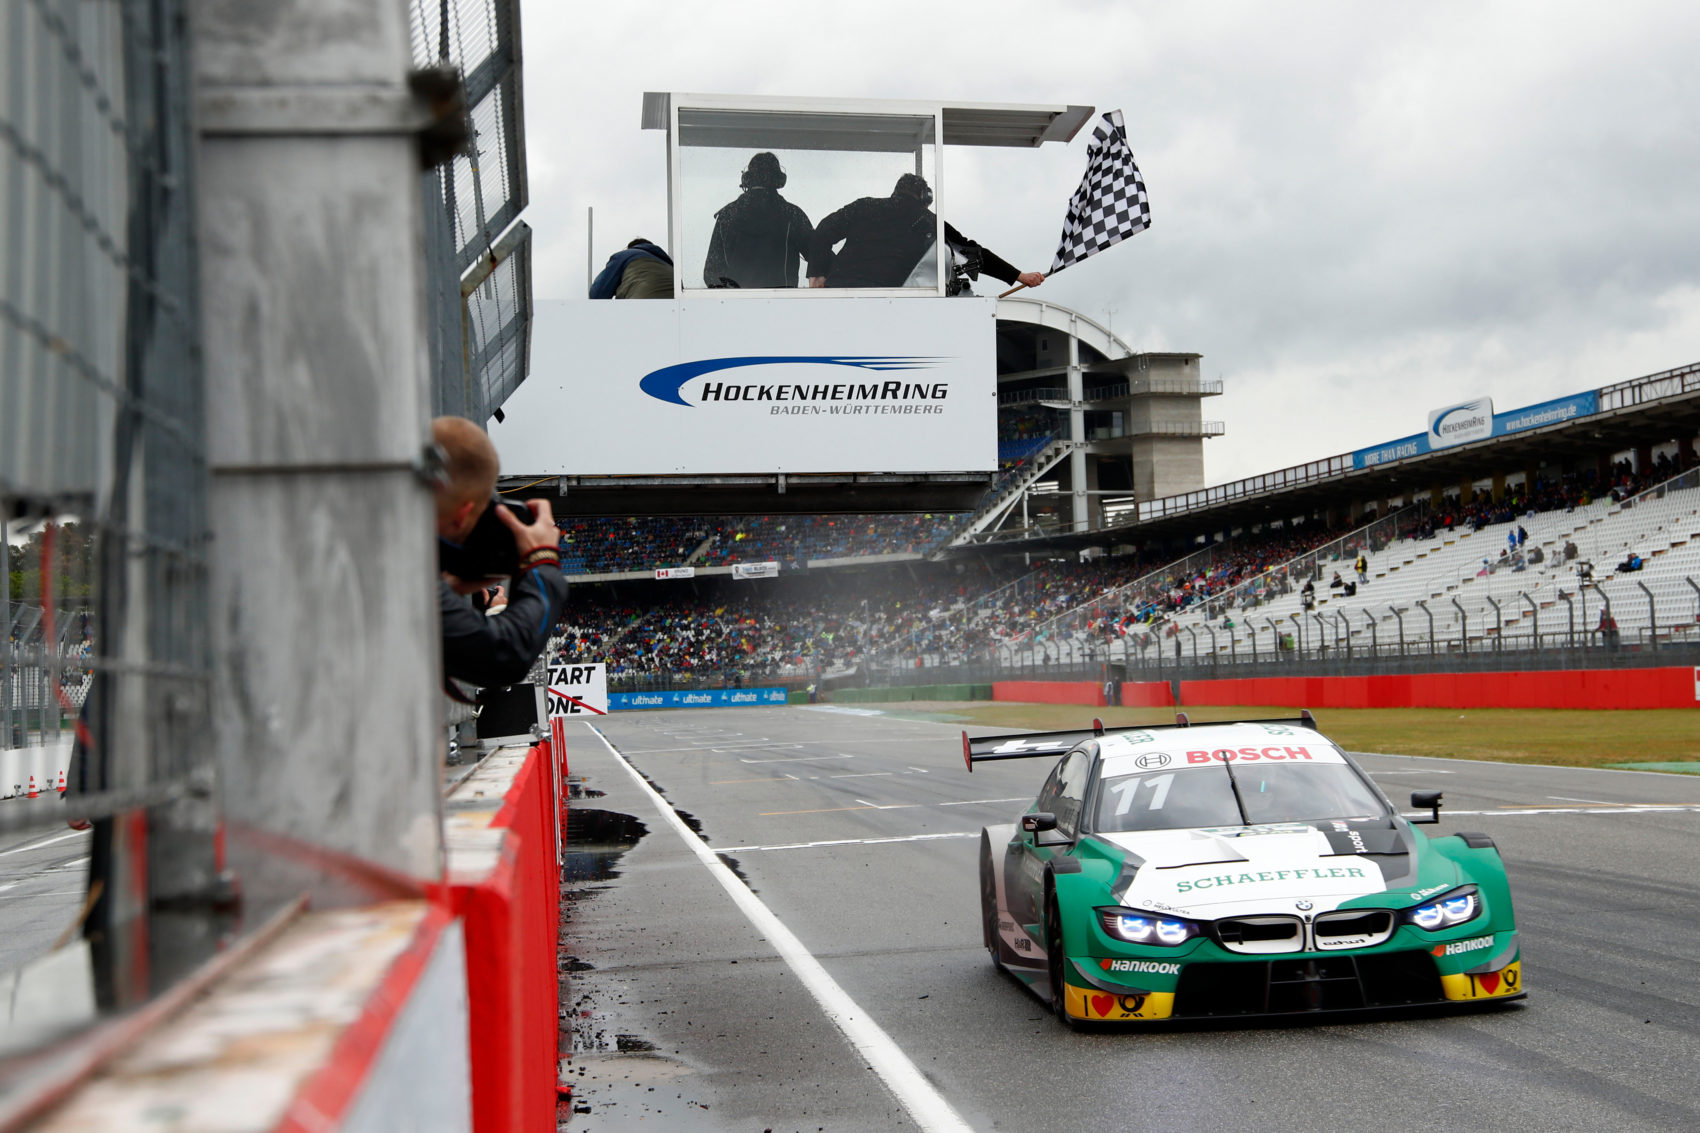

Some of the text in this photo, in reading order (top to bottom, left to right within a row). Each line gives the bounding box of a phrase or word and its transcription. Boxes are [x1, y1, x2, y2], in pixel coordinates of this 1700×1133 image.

[701, 381, 948, 401] HOCKENHEIMRING
[770, 404, 944, 415] BADEN-WÜRTTEMBERG
[1506, 404, 1577, 431] www.hockenheimring.de
[1364, 442, 1417, 466] MORE THAN RACING
[547, 666, 596, 685] TART
[548, 696, 583, 714] ONE
[631, 695, 663, 705] ultimate
[683, 694, 712, 703] ultimate
[731, 692, 757, 702] ultimate
[1186, 747, 1312, 764] BOSCH
[1110, 773, 1176, 816] 11
[1348, 831, 1368, 853] sport
[1176, 867, 1365, 893] SCHAEFFLER
